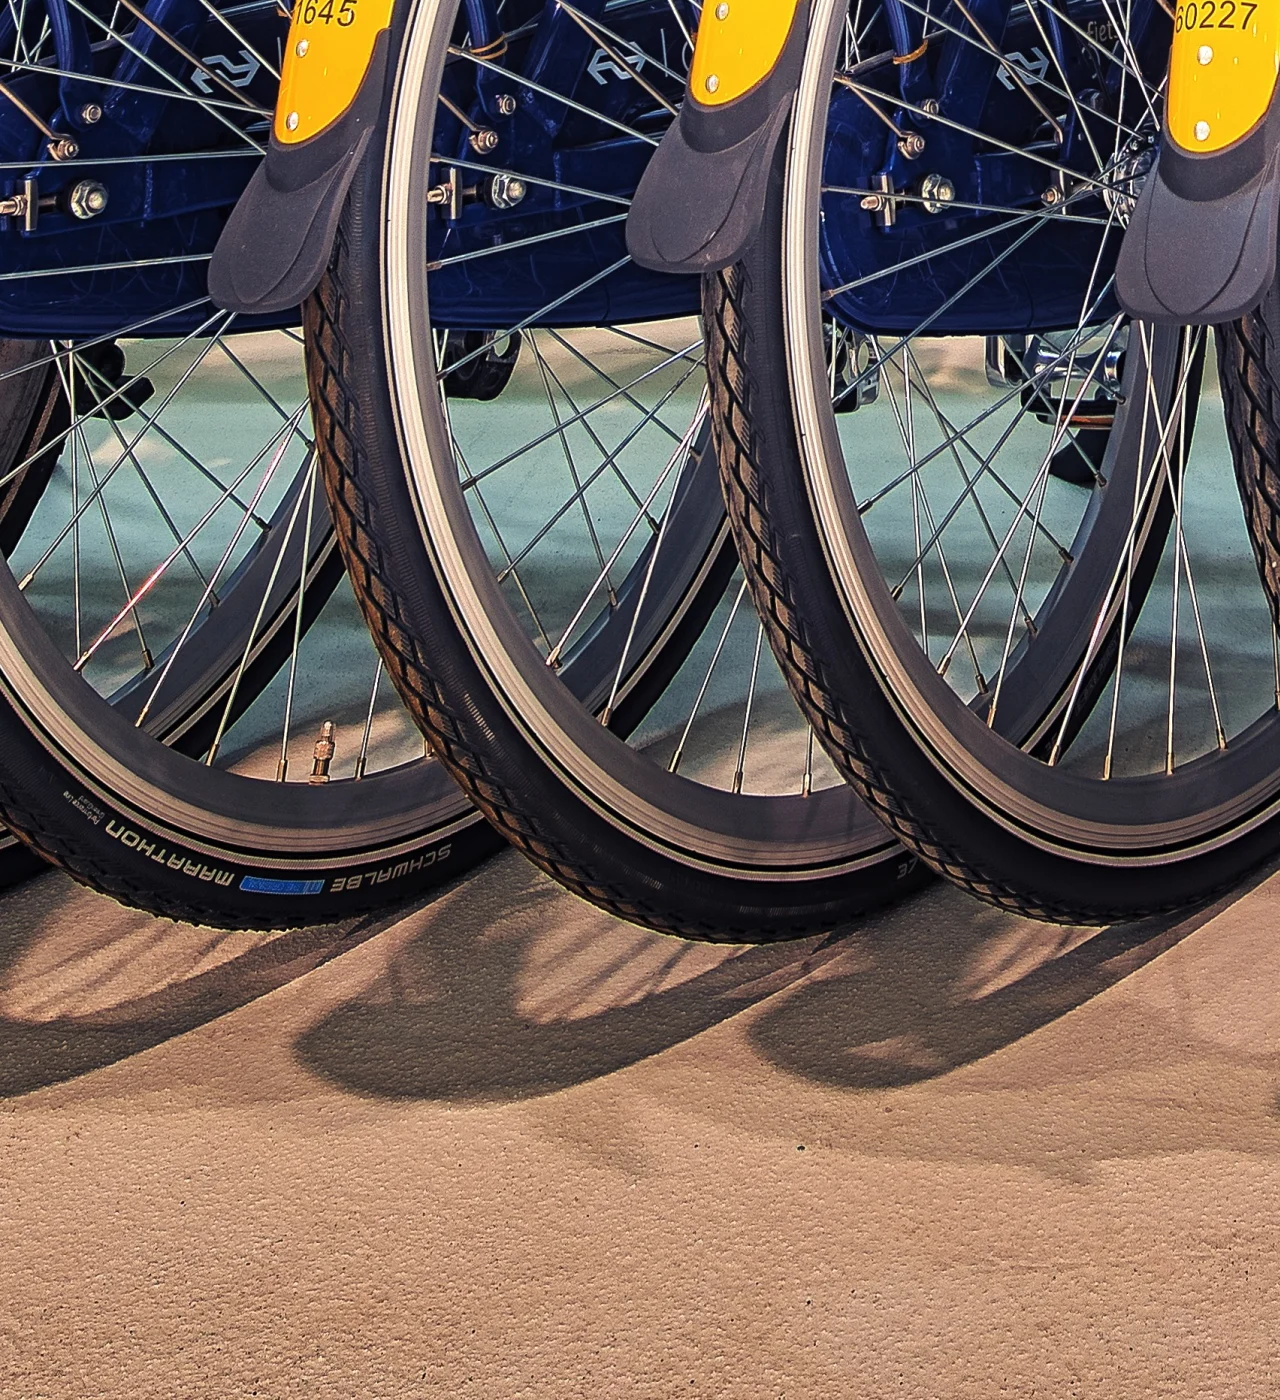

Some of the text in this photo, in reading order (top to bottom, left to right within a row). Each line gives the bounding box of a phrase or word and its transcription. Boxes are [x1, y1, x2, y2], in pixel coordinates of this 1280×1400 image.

[1175, 0, 1258, 34] 60227
[105, 819, 236, 887] MARATHON
[329, 843, 452, 893] SCHWALBE
